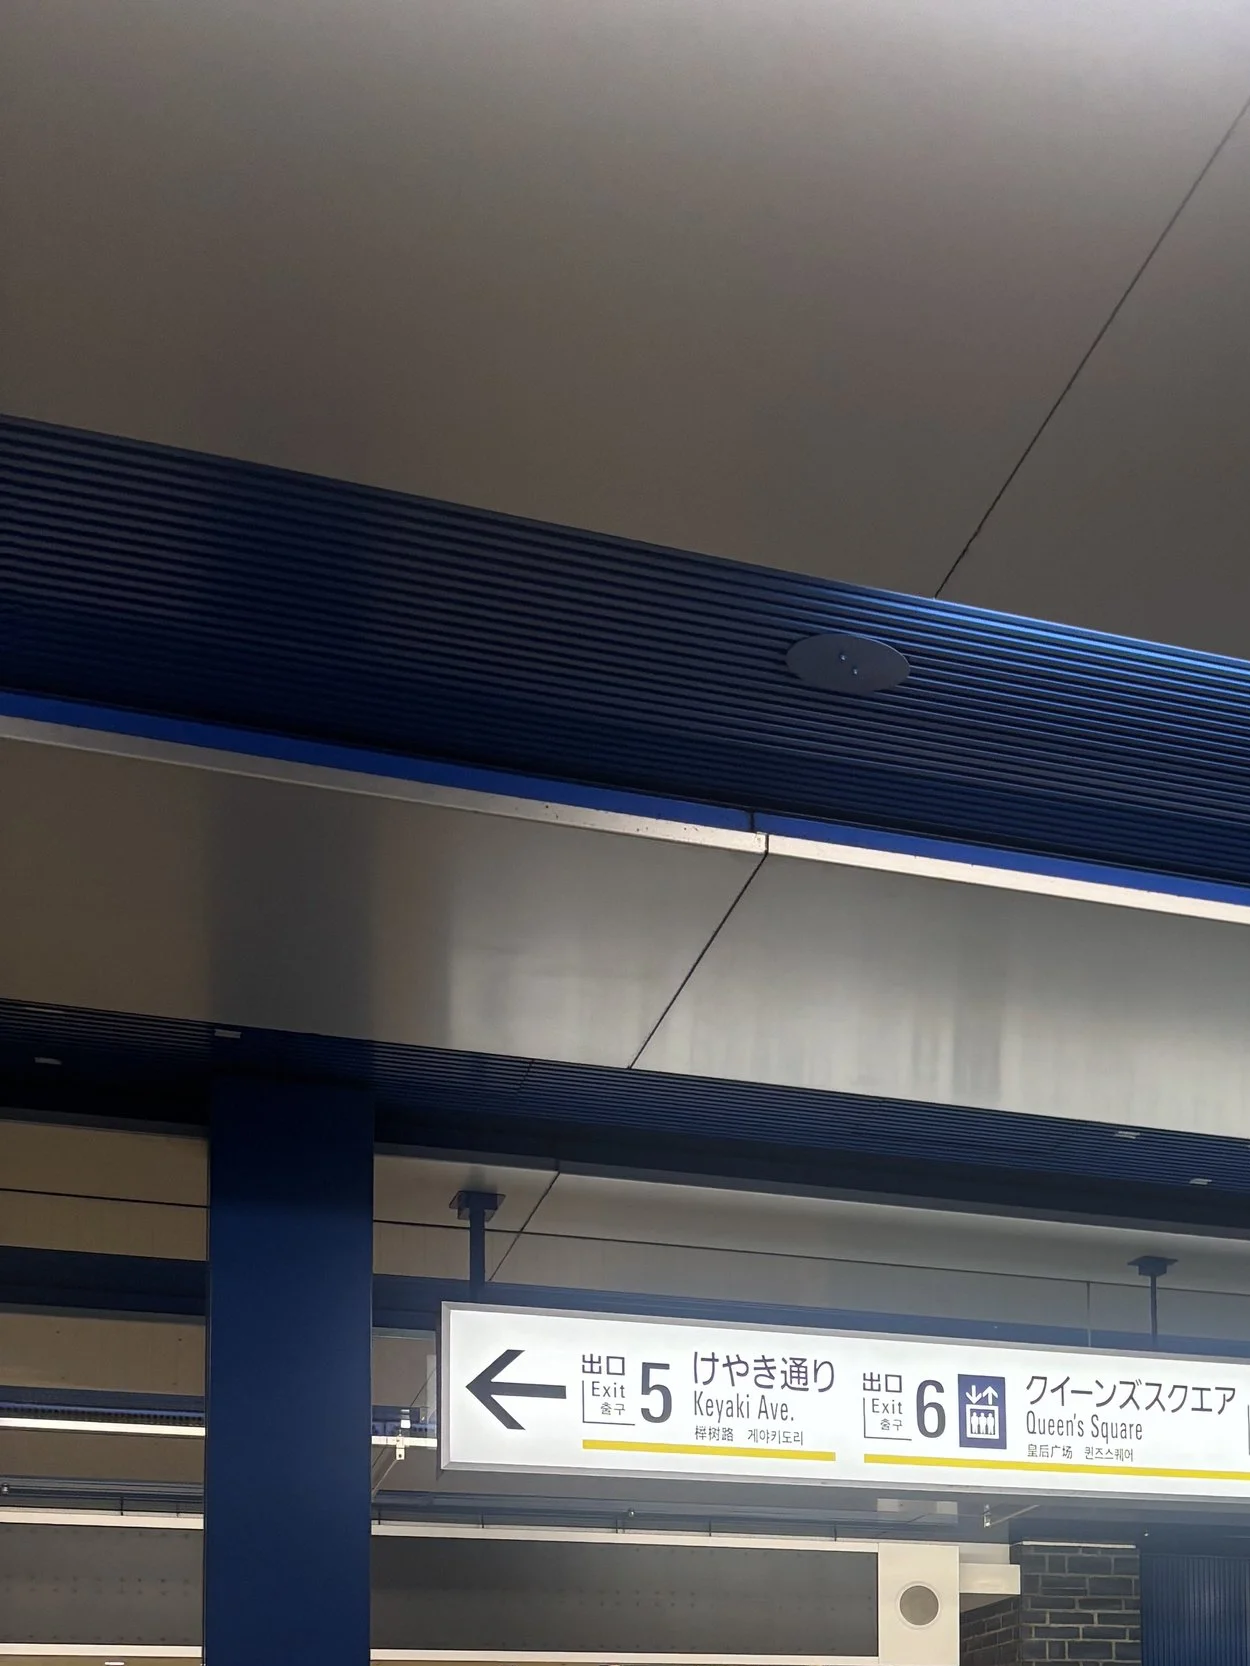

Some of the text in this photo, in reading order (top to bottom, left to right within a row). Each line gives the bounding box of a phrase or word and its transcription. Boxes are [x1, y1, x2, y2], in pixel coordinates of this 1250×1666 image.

[582, 1353, 625, 1376] 出口
[693, 1351, 835, 1393] けやき通り
[591, 1381, 626, 1398] Exit
[641, 1361, 673, 1424] 5
[863, 1372, 902, 1393] 出口
[1026, 1375, 1236, 1415] クイーンズスクエア
[600, 1402, 626, 1416] 출구
[693, 1391, 794, 1423] Keyaki Ave.
[871, 1398, 903, 1415] Exit
[915, 1379, 946, 1438] 6
[880, 1418, 903, 1431] 출구
[1026, 1410, 1143, 1444] Queen's Square
[747, 1429, 804, 1446] 게야키도리
[1027, 1444, 1073, 1460] 皇后广场
